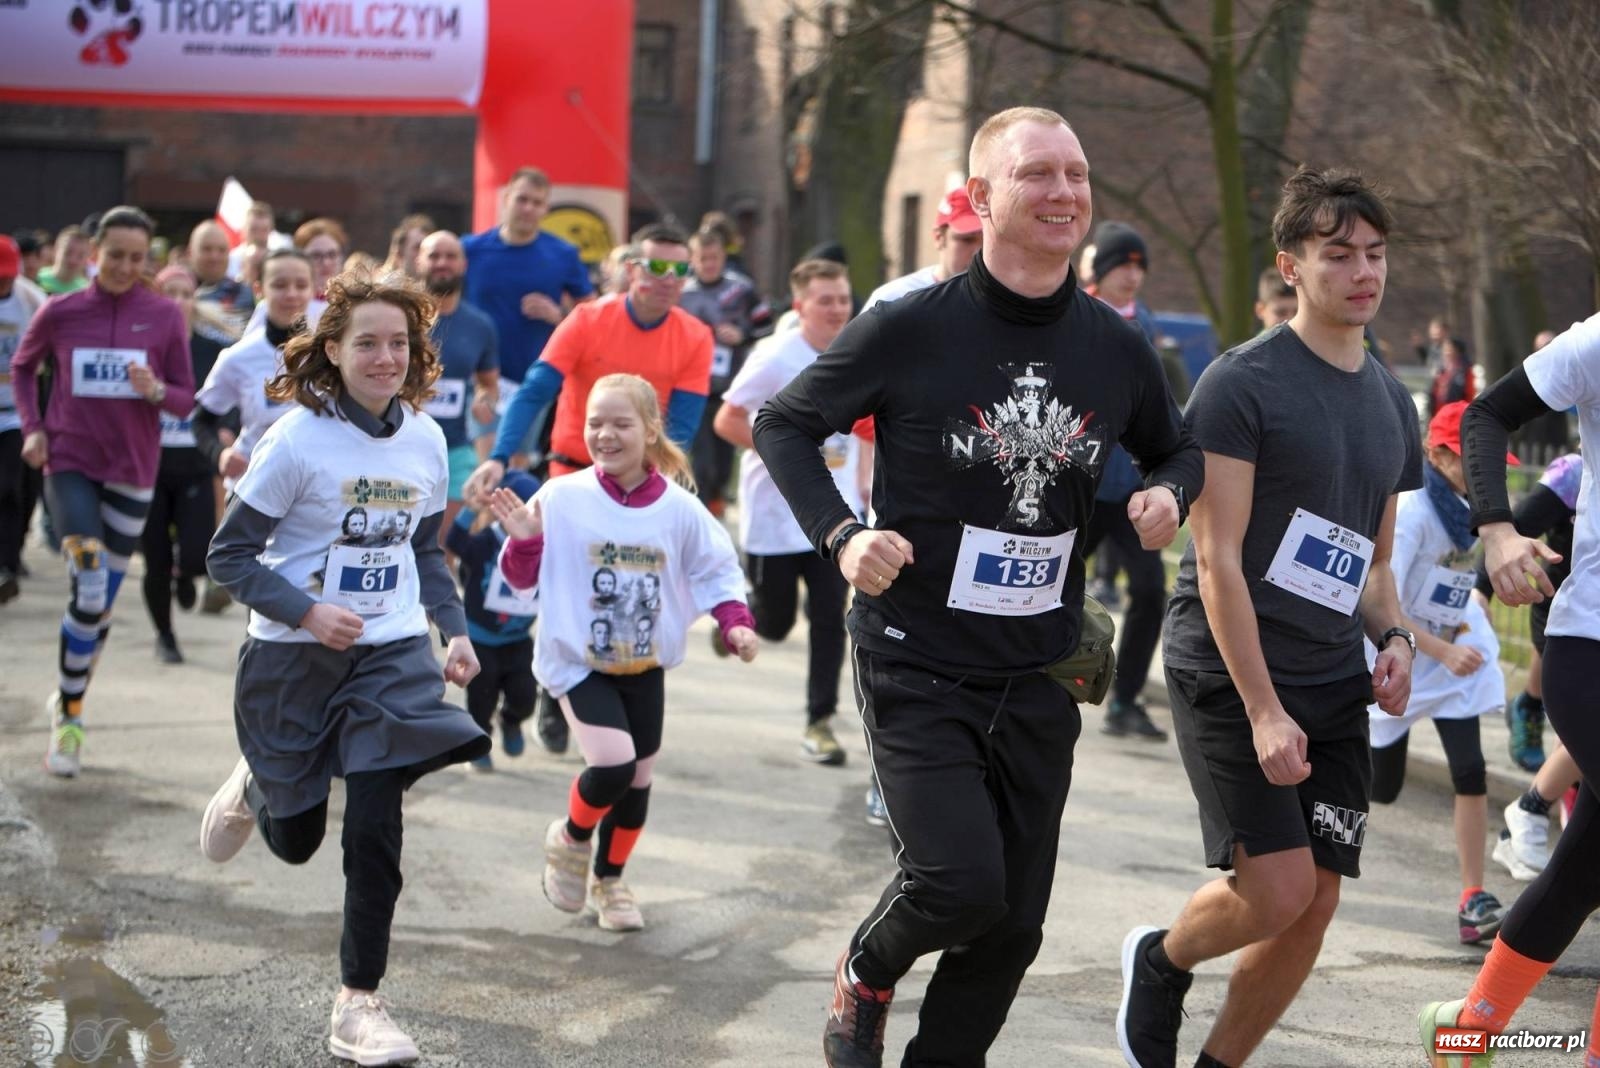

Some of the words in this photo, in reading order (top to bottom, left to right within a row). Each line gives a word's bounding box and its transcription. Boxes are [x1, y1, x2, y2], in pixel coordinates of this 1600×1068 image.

[950, 434, 975, 459] N
[1016, 498, 1040, 527] S
[1019, 546, 1052, 555] WILCZYM
[1325, 548, 1352, 578] 10
[361, 569, 387, 591] 61
[998, 559, 1050, 586] 138
[1446, 588, 1466, 607] 91
